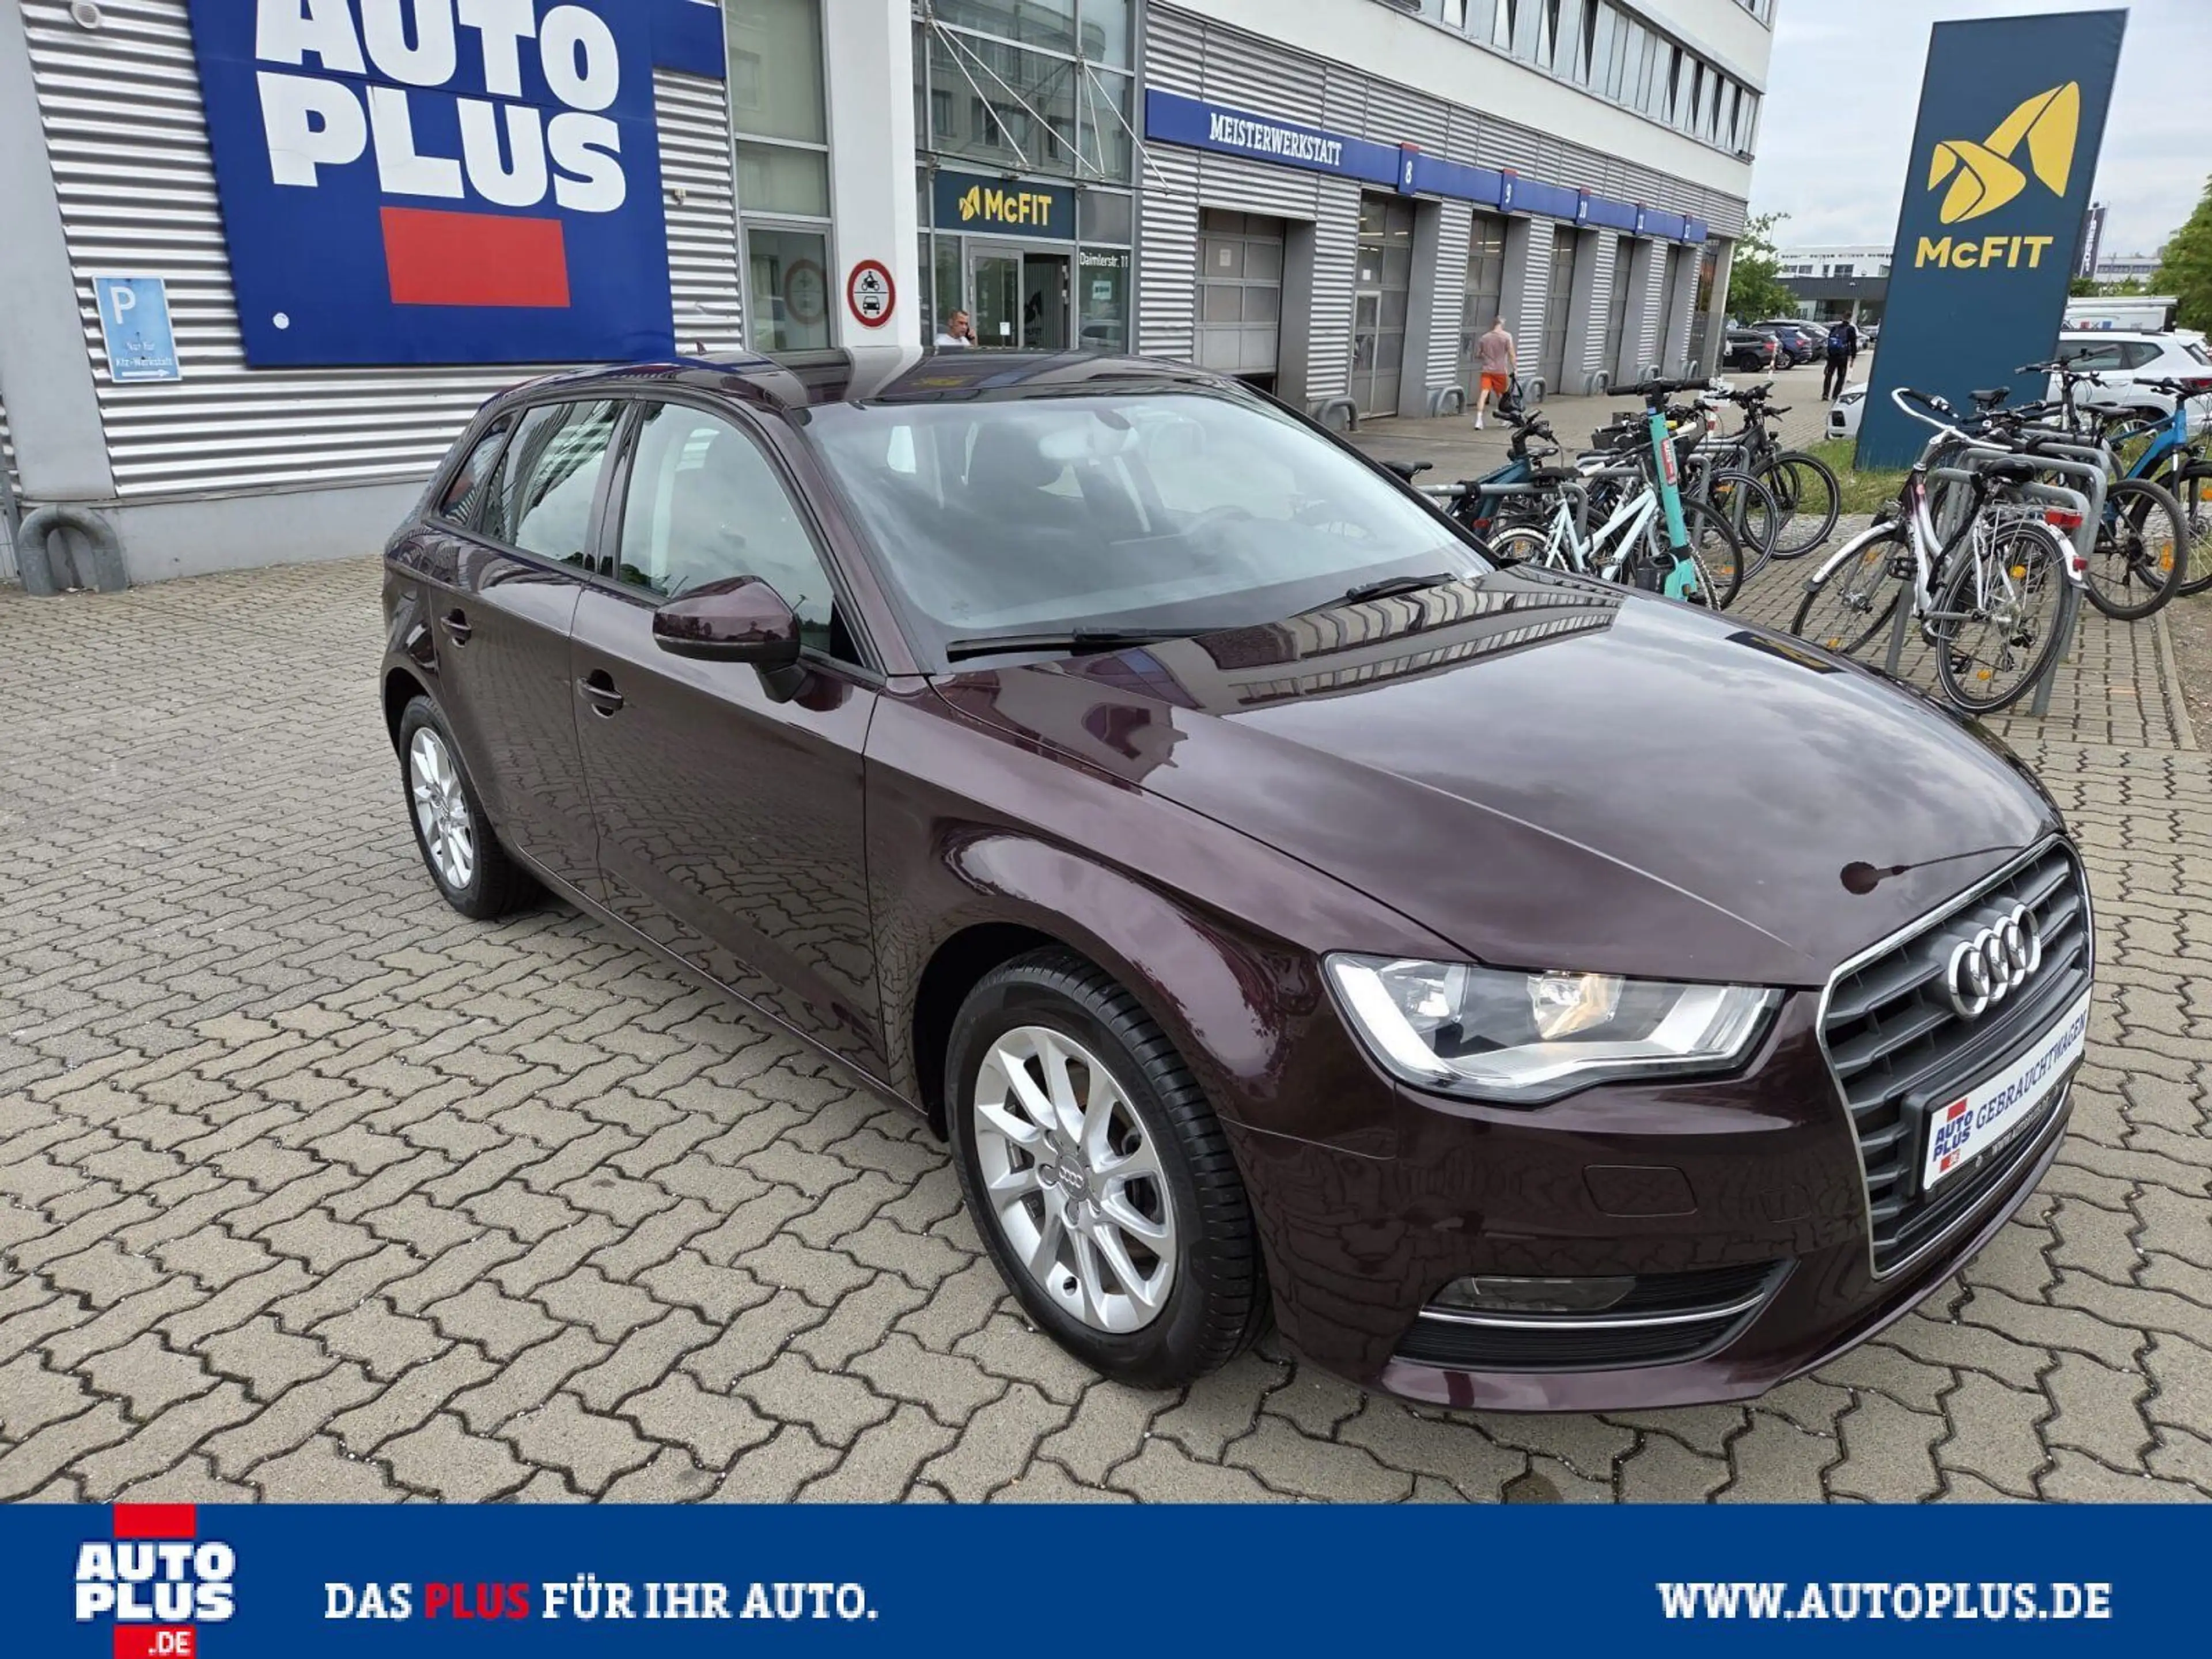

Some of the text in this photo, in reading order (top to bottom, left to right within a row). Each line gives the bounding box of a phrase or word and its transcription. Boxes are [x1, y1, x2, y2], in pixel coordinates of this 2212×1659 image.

[256, 0, 619, 111] AUTO
[256, 71, 626, 213] PLUS
[1210, 113, 1342, 166] MEISTERWERKSTATT
[1405, 160, 1413, 185] 8
[984, 188, 1052, 226] McFIT
[1079, 252, 1128, 268] Daimlerstr. 11
[1914, 236, 2054, 268] McFIT
[110, 286, 136, 325] P
[1936, 1110, 1974, 1145] AUTO
[1976, 1009, 2087, 1130] GEBRAUCHTWAGEN
[1933, 1127, 1971, 1162] PLUS
